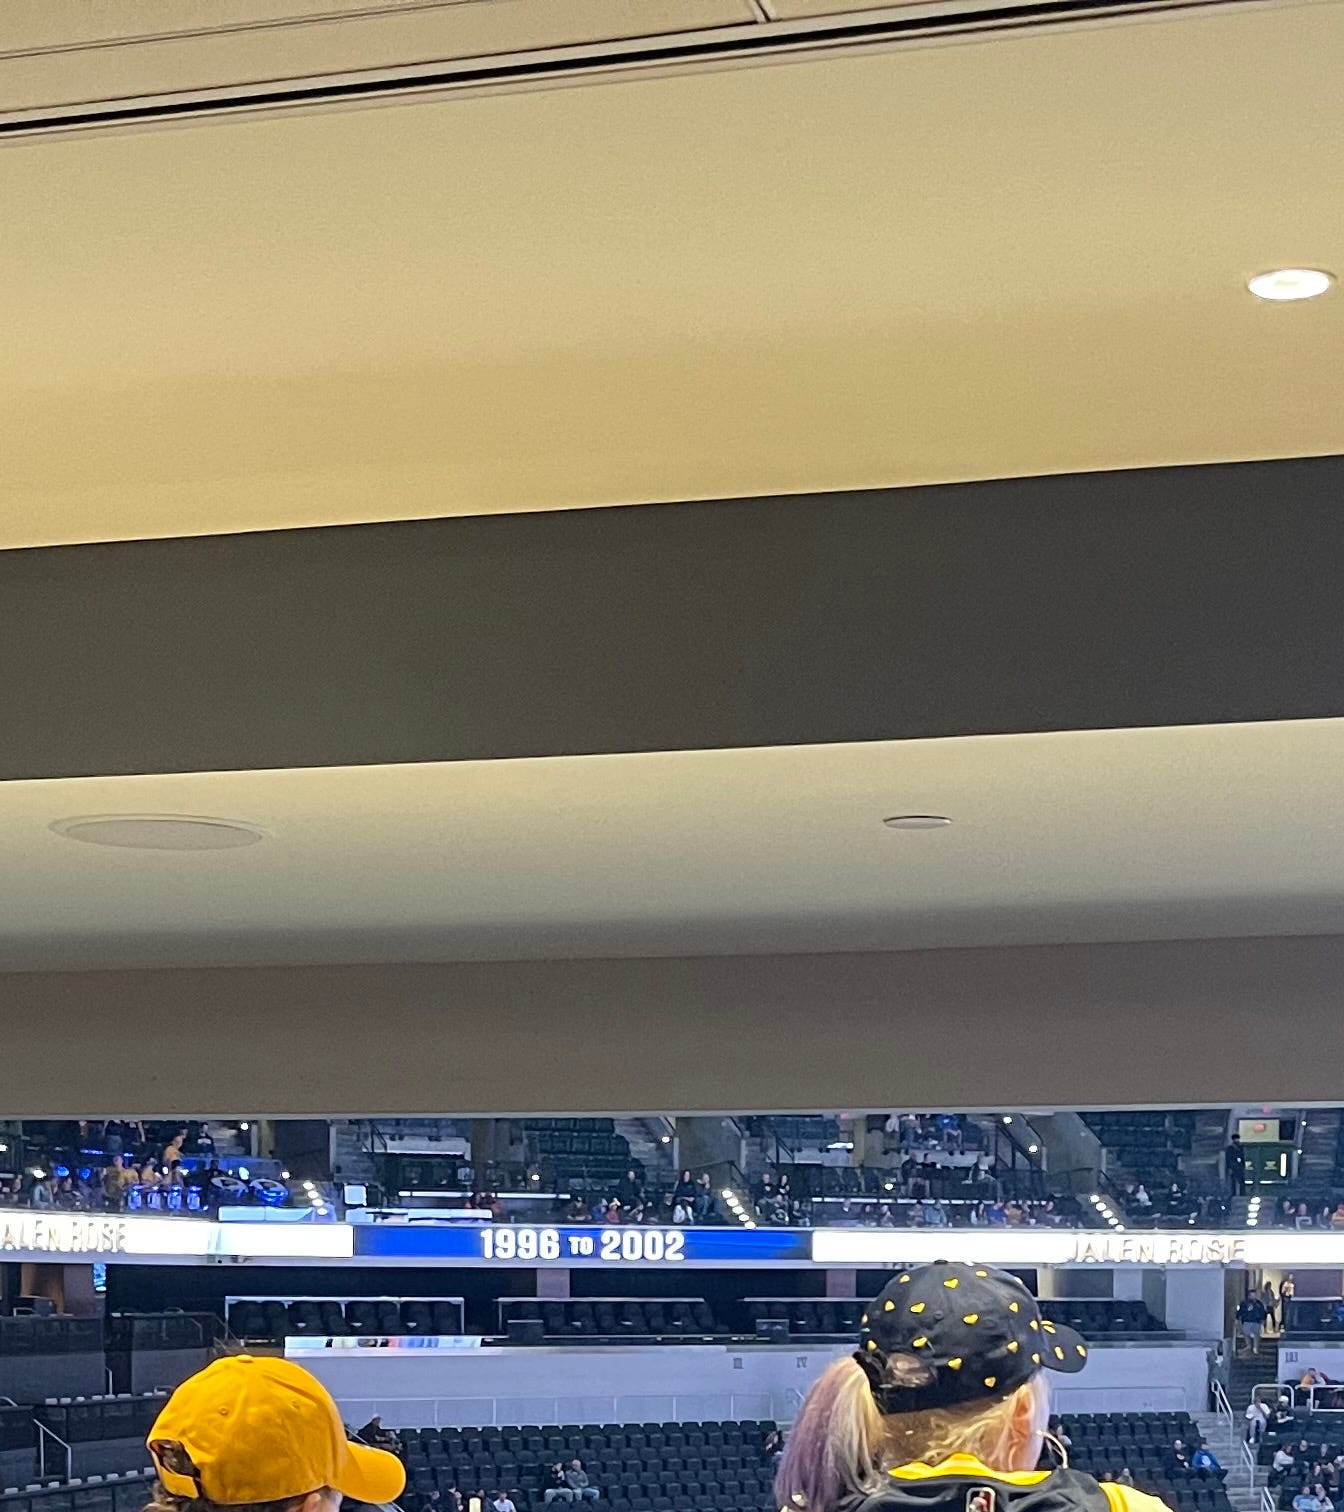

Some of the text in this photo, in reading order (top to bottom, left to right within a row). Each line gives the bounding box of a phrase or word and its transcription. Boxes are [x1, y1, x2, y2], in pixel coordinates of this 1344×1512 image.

[481, 1229, 685, 1261] 1996 TO 2002
[1069, 1239, 1155, 1261] JALEN
